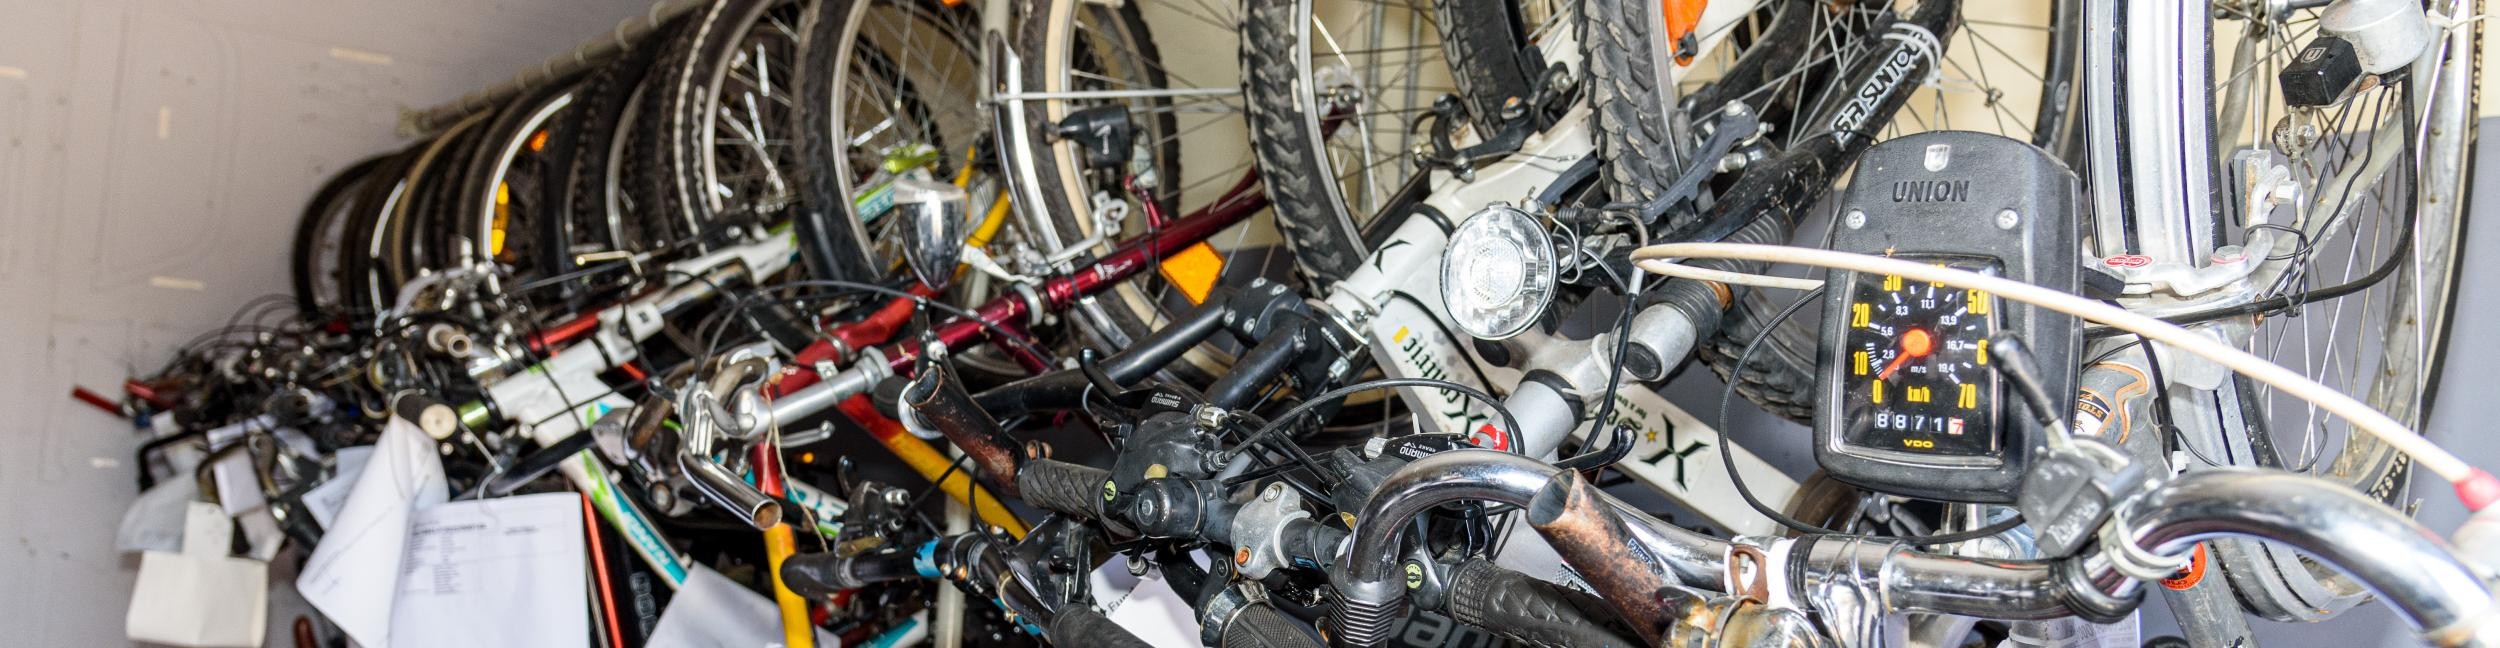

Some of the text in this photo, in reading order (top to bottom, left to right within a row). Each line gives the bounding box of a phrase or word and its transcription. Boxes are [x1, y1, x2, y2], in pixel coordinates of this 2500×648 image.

[1892, 179, 1970, 202] UNION
[1883, 272, 1903, 291] 30
[1921, 299, 1935, 310] 11,1
[1967, 288, 1989, 314] 50
[1852, 303, 1870, 328] 20
[1895, 305, 1909, 316] 8,3
[1940, 315, 1957, 326] 13,9
[1881, 326, 1893, 337] 5,6
[1946, 340, 1965, 352] 16,7
[1976, 339, 1989, 365] 6
[1882, 349, 1895, 359] 2,8
[1854, 351, 1868, 375] 10
[1910, 365, 1927, 374] m/s
[1938, 363, 1956, 373] 19,4
[1872, 379, 1882, 404] 0
[1907, 386, 1931, 403] km/h
[1958, 383, 1977, 409] 70
[1903, 439, 1935, 448] VDO
